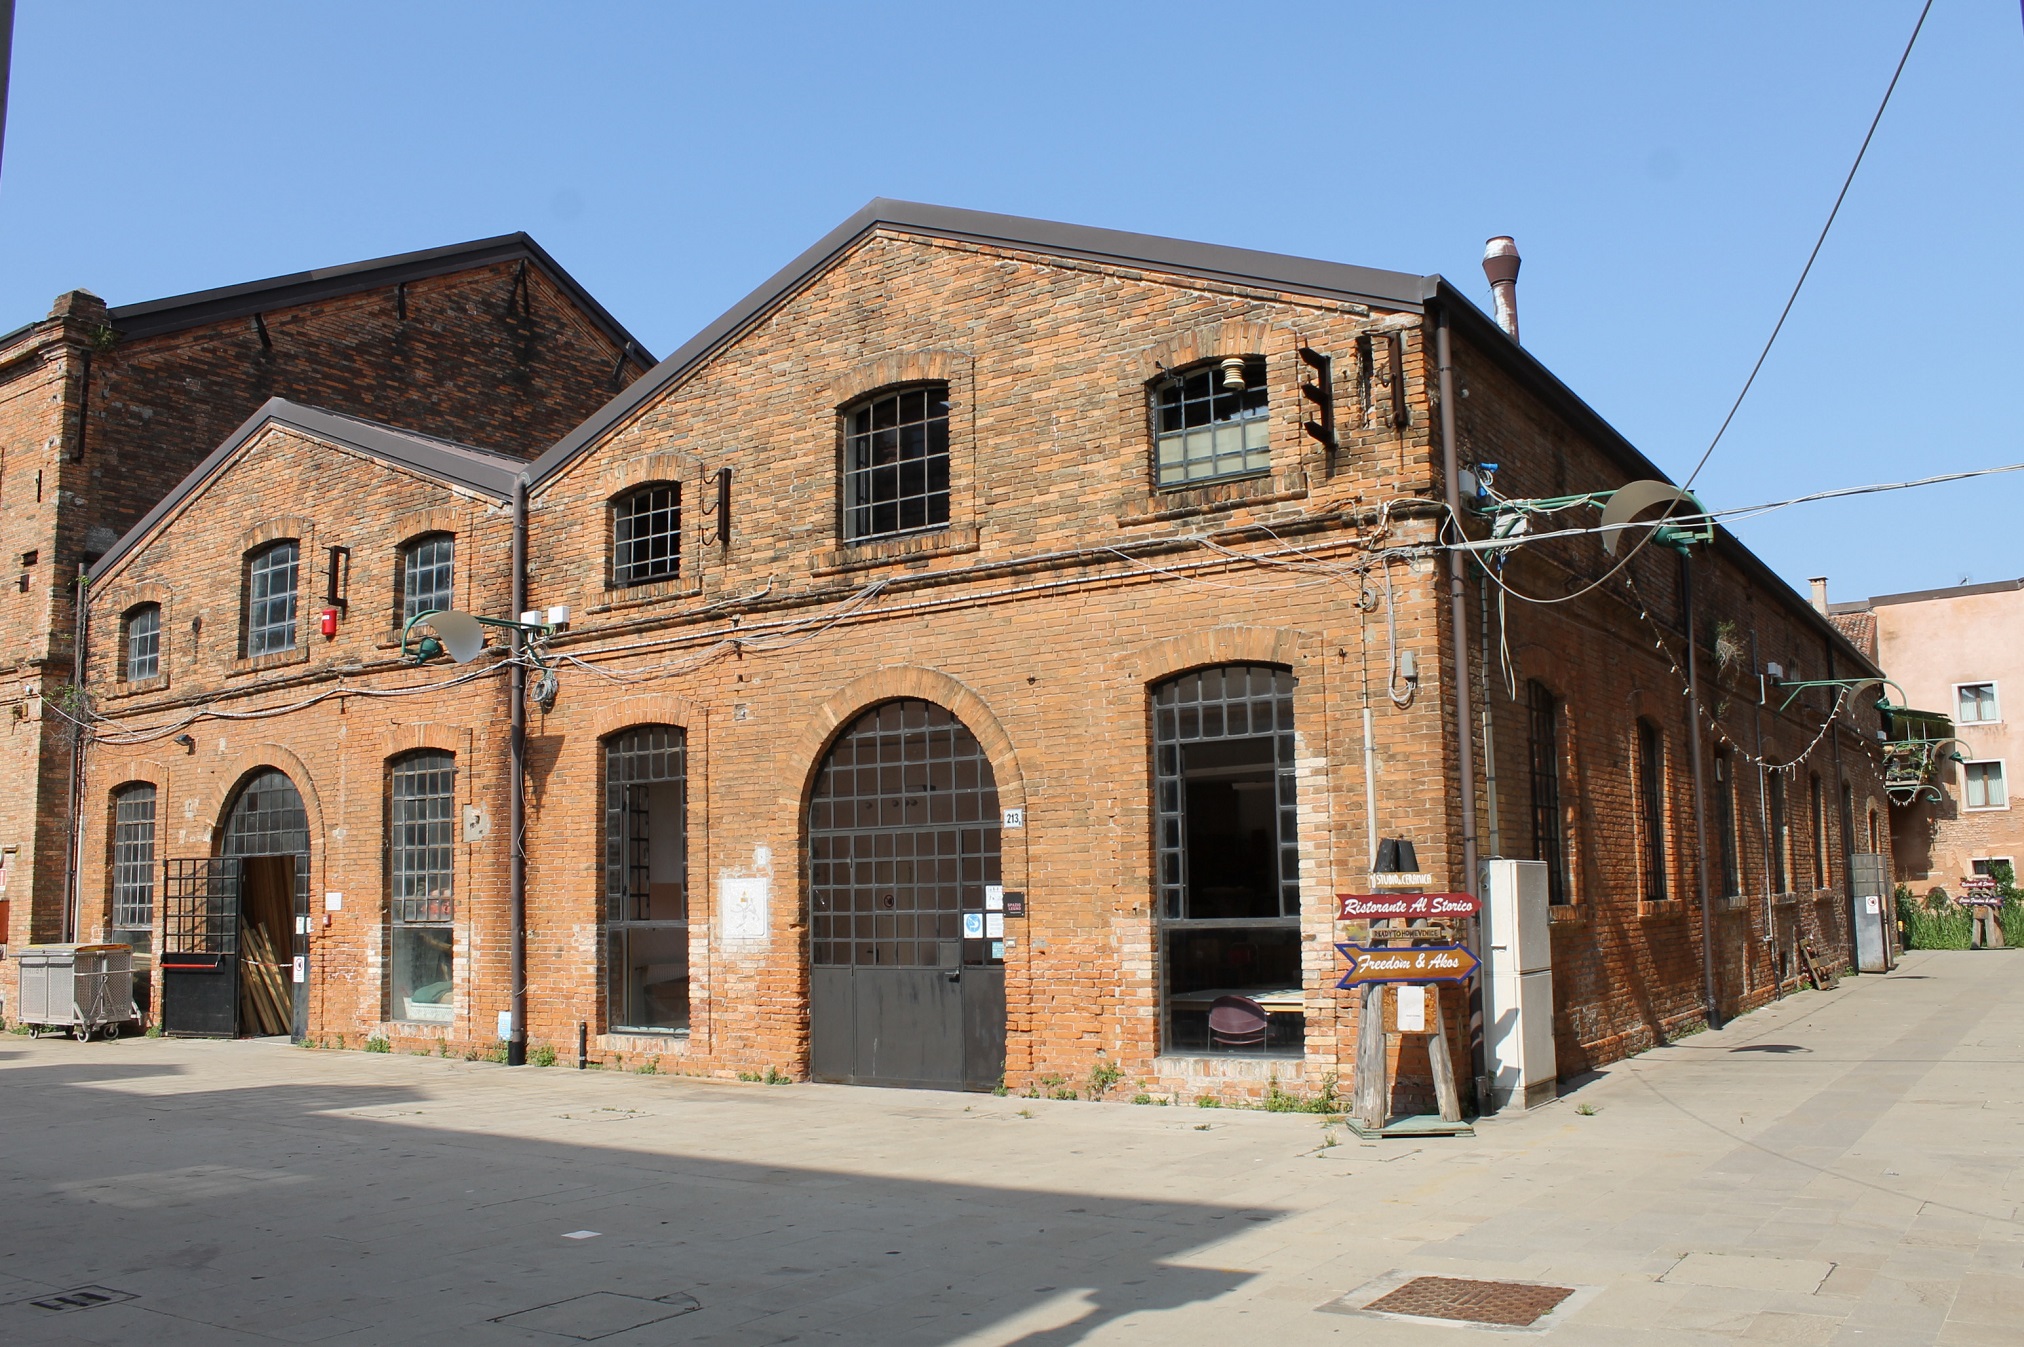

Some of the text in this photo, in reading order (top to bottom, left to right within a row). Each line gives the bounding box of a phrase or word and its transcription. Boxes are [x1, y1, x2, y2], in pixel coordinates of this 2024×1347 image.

[1007, 813, 1019, 823] 213
[1376, 874, 1398, 885] STUDIO
[1402, 873, 1432, 884] CERAMICA
[1344, 897, 1473, 915] Ristorante Al Storico
[1358, 952, 1459, 973] Freedom & Akos
